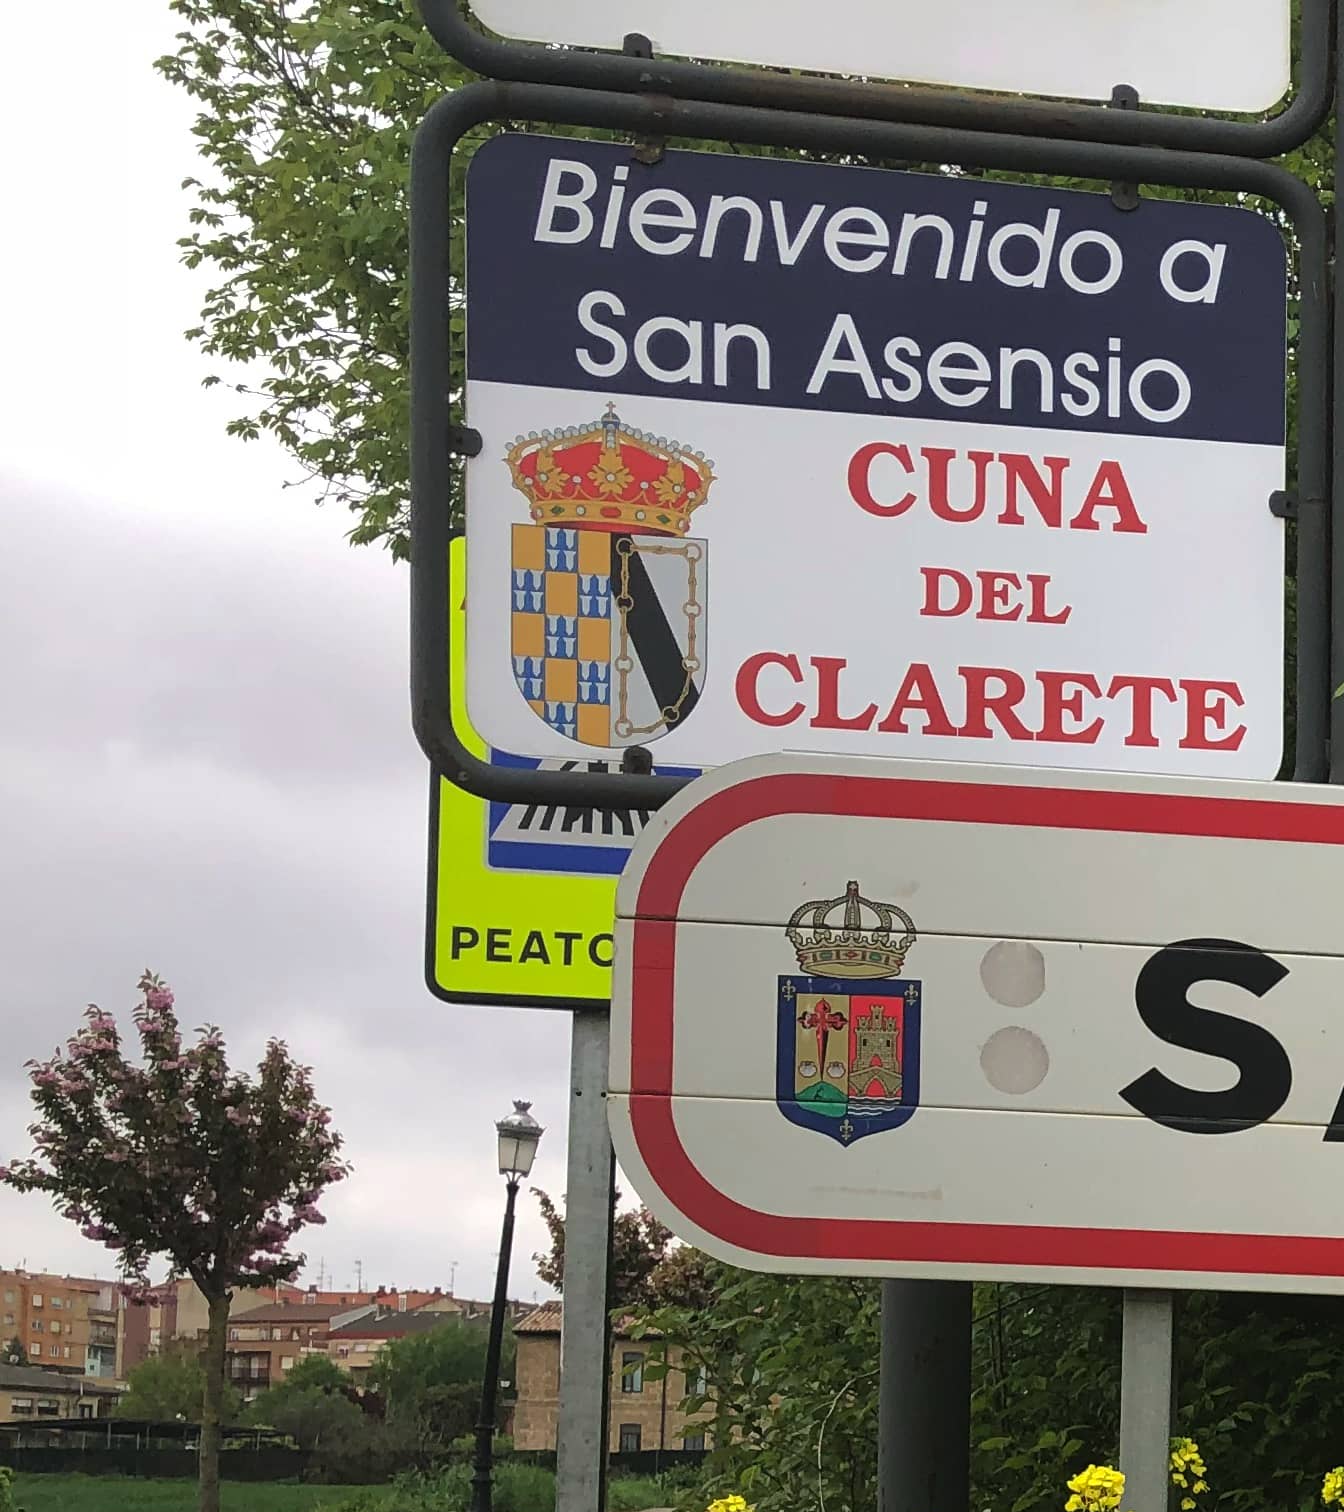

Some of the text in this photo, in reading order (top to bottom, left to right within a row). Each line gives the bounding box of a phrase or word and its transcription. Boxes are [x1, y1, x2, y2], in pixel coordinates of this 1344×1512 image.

[533, 157, 1227, 304] Bienvenido a
[574, 289, 1193, 423] San Asensio
[847, 442, 1148, 535] CUNA
[920, 567, 1072, 625] DEL
[734, 651, 1247, 752] CLARETE
